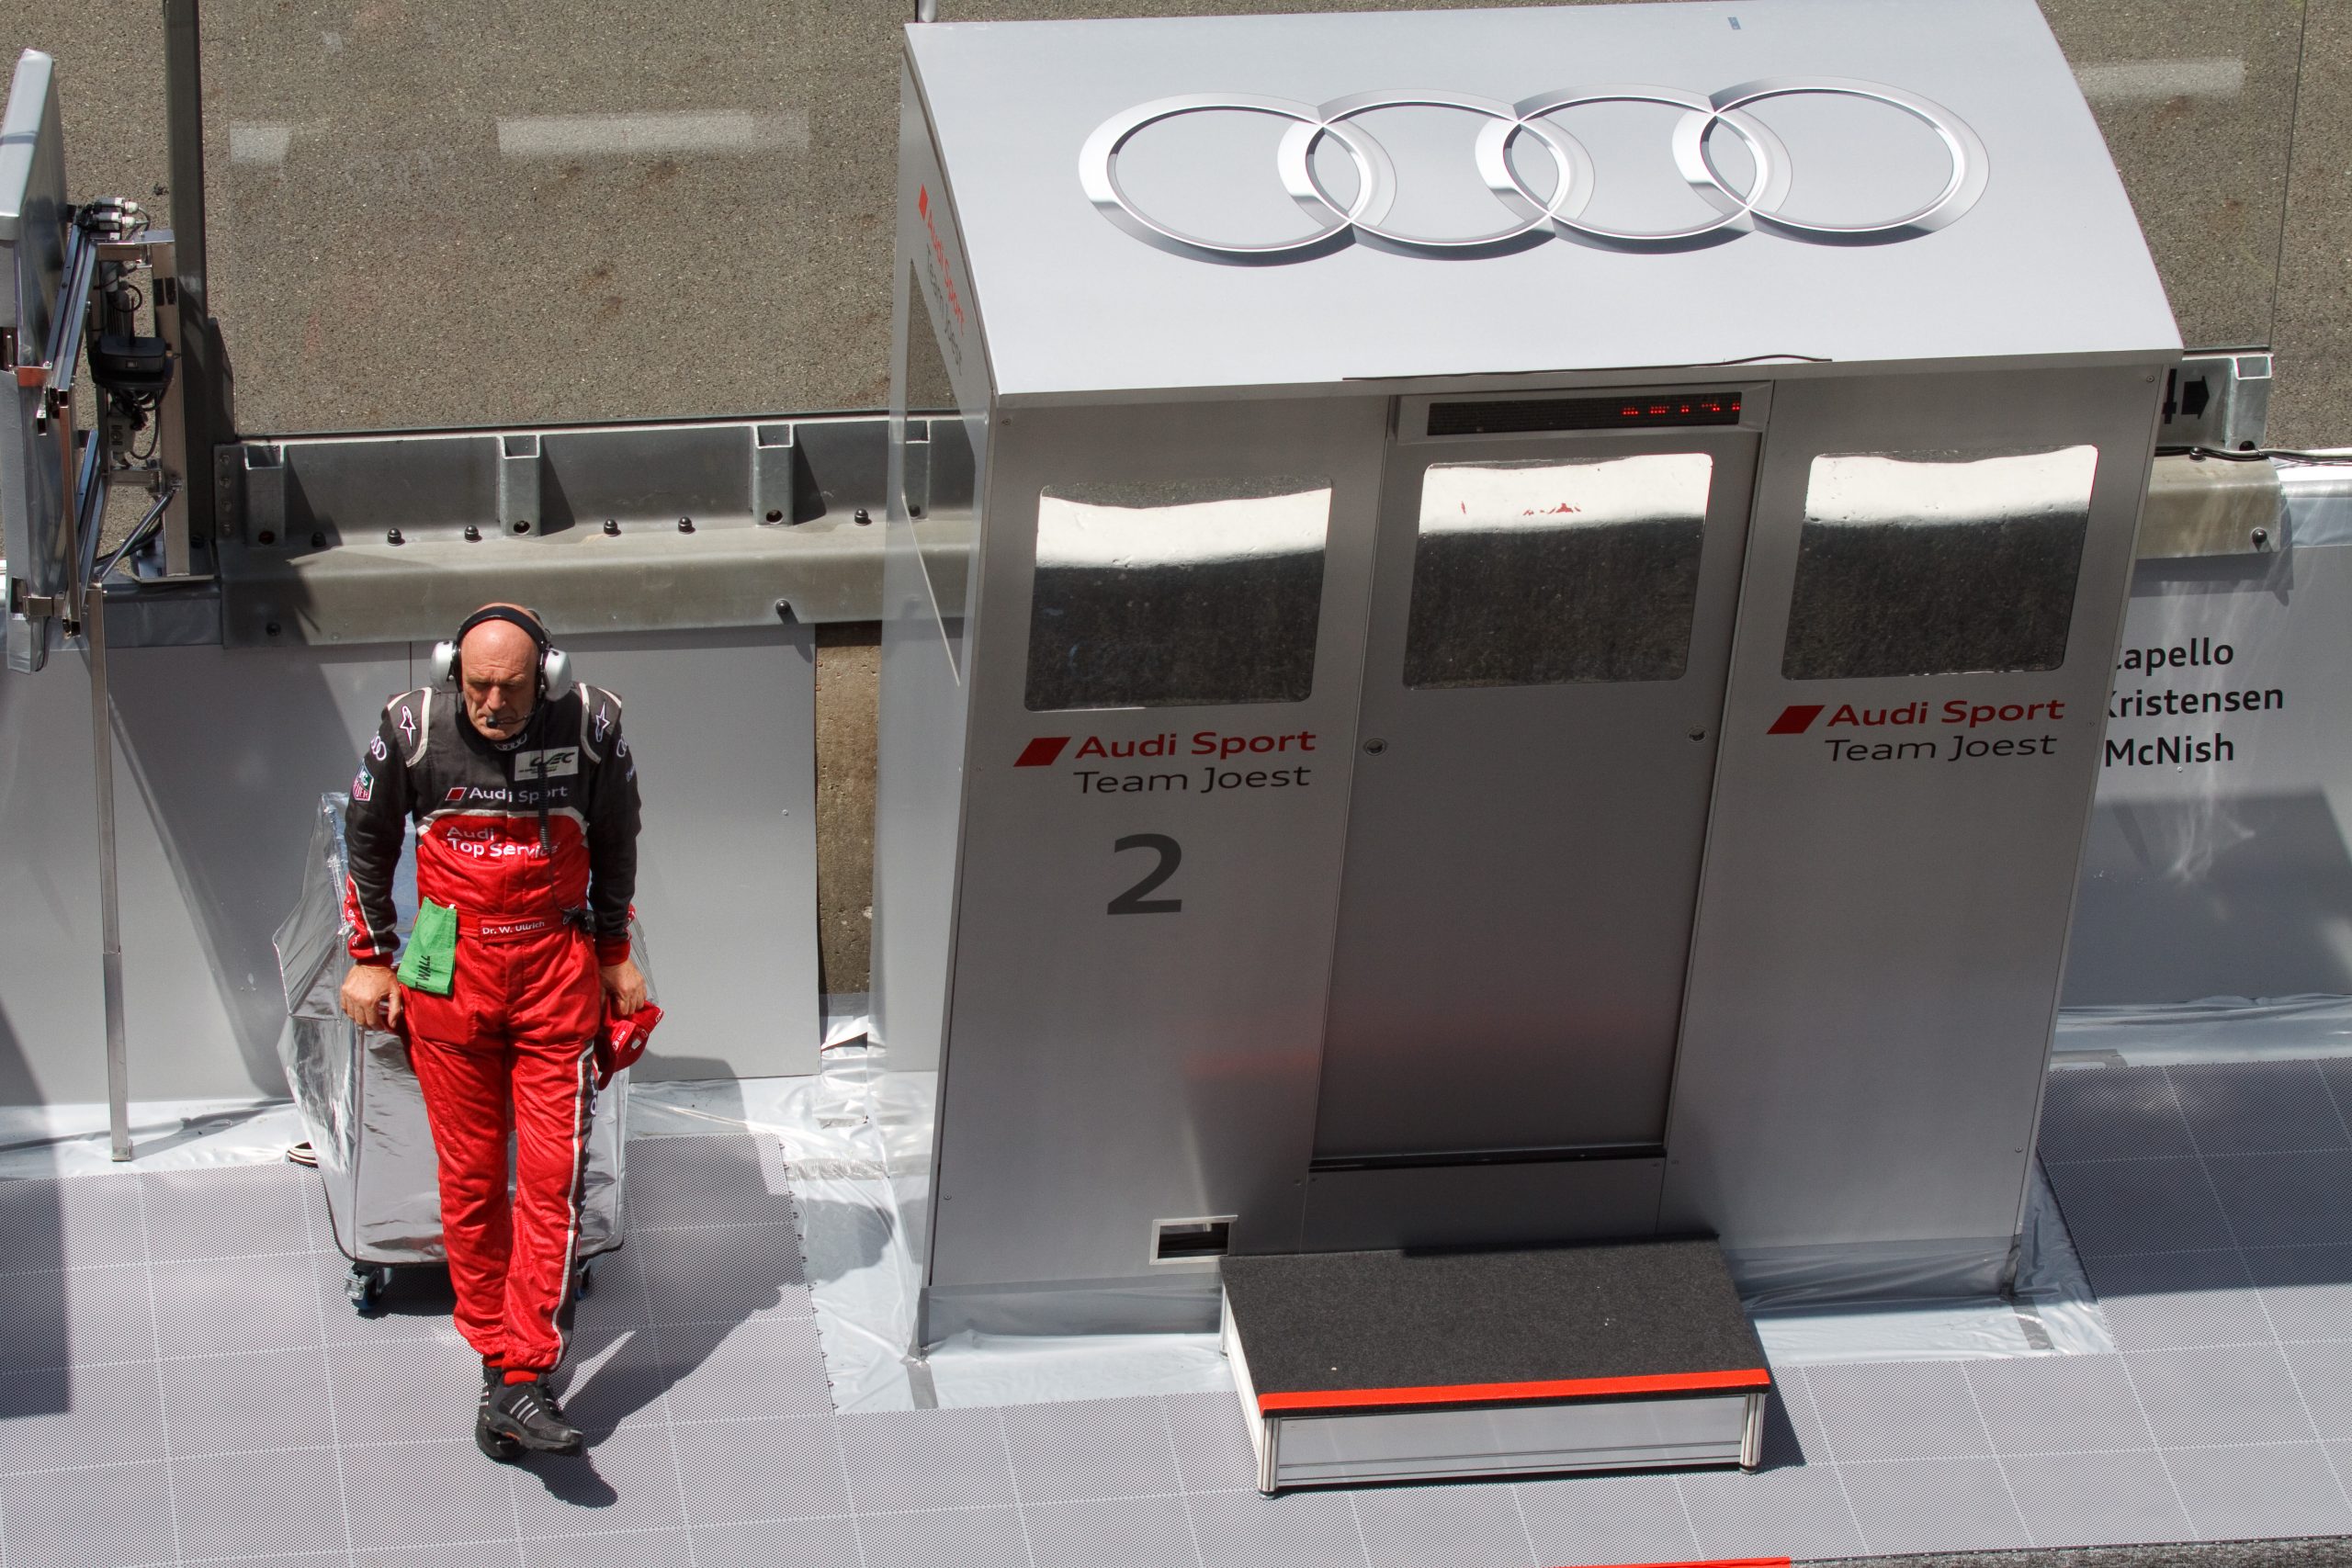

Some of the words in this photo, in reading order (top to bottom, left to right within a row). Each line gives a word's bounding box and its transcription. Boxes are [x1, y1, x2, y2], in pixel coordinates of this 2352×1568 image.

[927, 209, 944, 272] Audi
[944, 258, 965, 337] Sport
[926, 243, 944, 320] Team
[944, 303, 963, 377] Joest
[2117, 637, 2233, 676] apello
[1826, 702, 1928, 727] Audi
[1941, 700, 2065, 728] Sport
[1074, 733, 1177, 760] Audi
[1191, 731, 1317, 760] Sport
[1825, 739, 1936, 761] Team
[1947, 735, 2057, 761] Joest
[2106, 733, 2233, 767] McNish
[1073, 771, 1188, 794] Team
[1200, 766, 1312, 794] Joest
[469, 787, 513, 802] Audi
[447, 827, 494, 840] Audi
[447, 838, 484, 858] Top
[1107, 833, 1182, 915] 2
[482, 927, 496, 935] Dr.
[499, 926, 513, 934] W.
[515, 921, 545, 931] Ullrich
[416, 955, 431, 981] WALL
